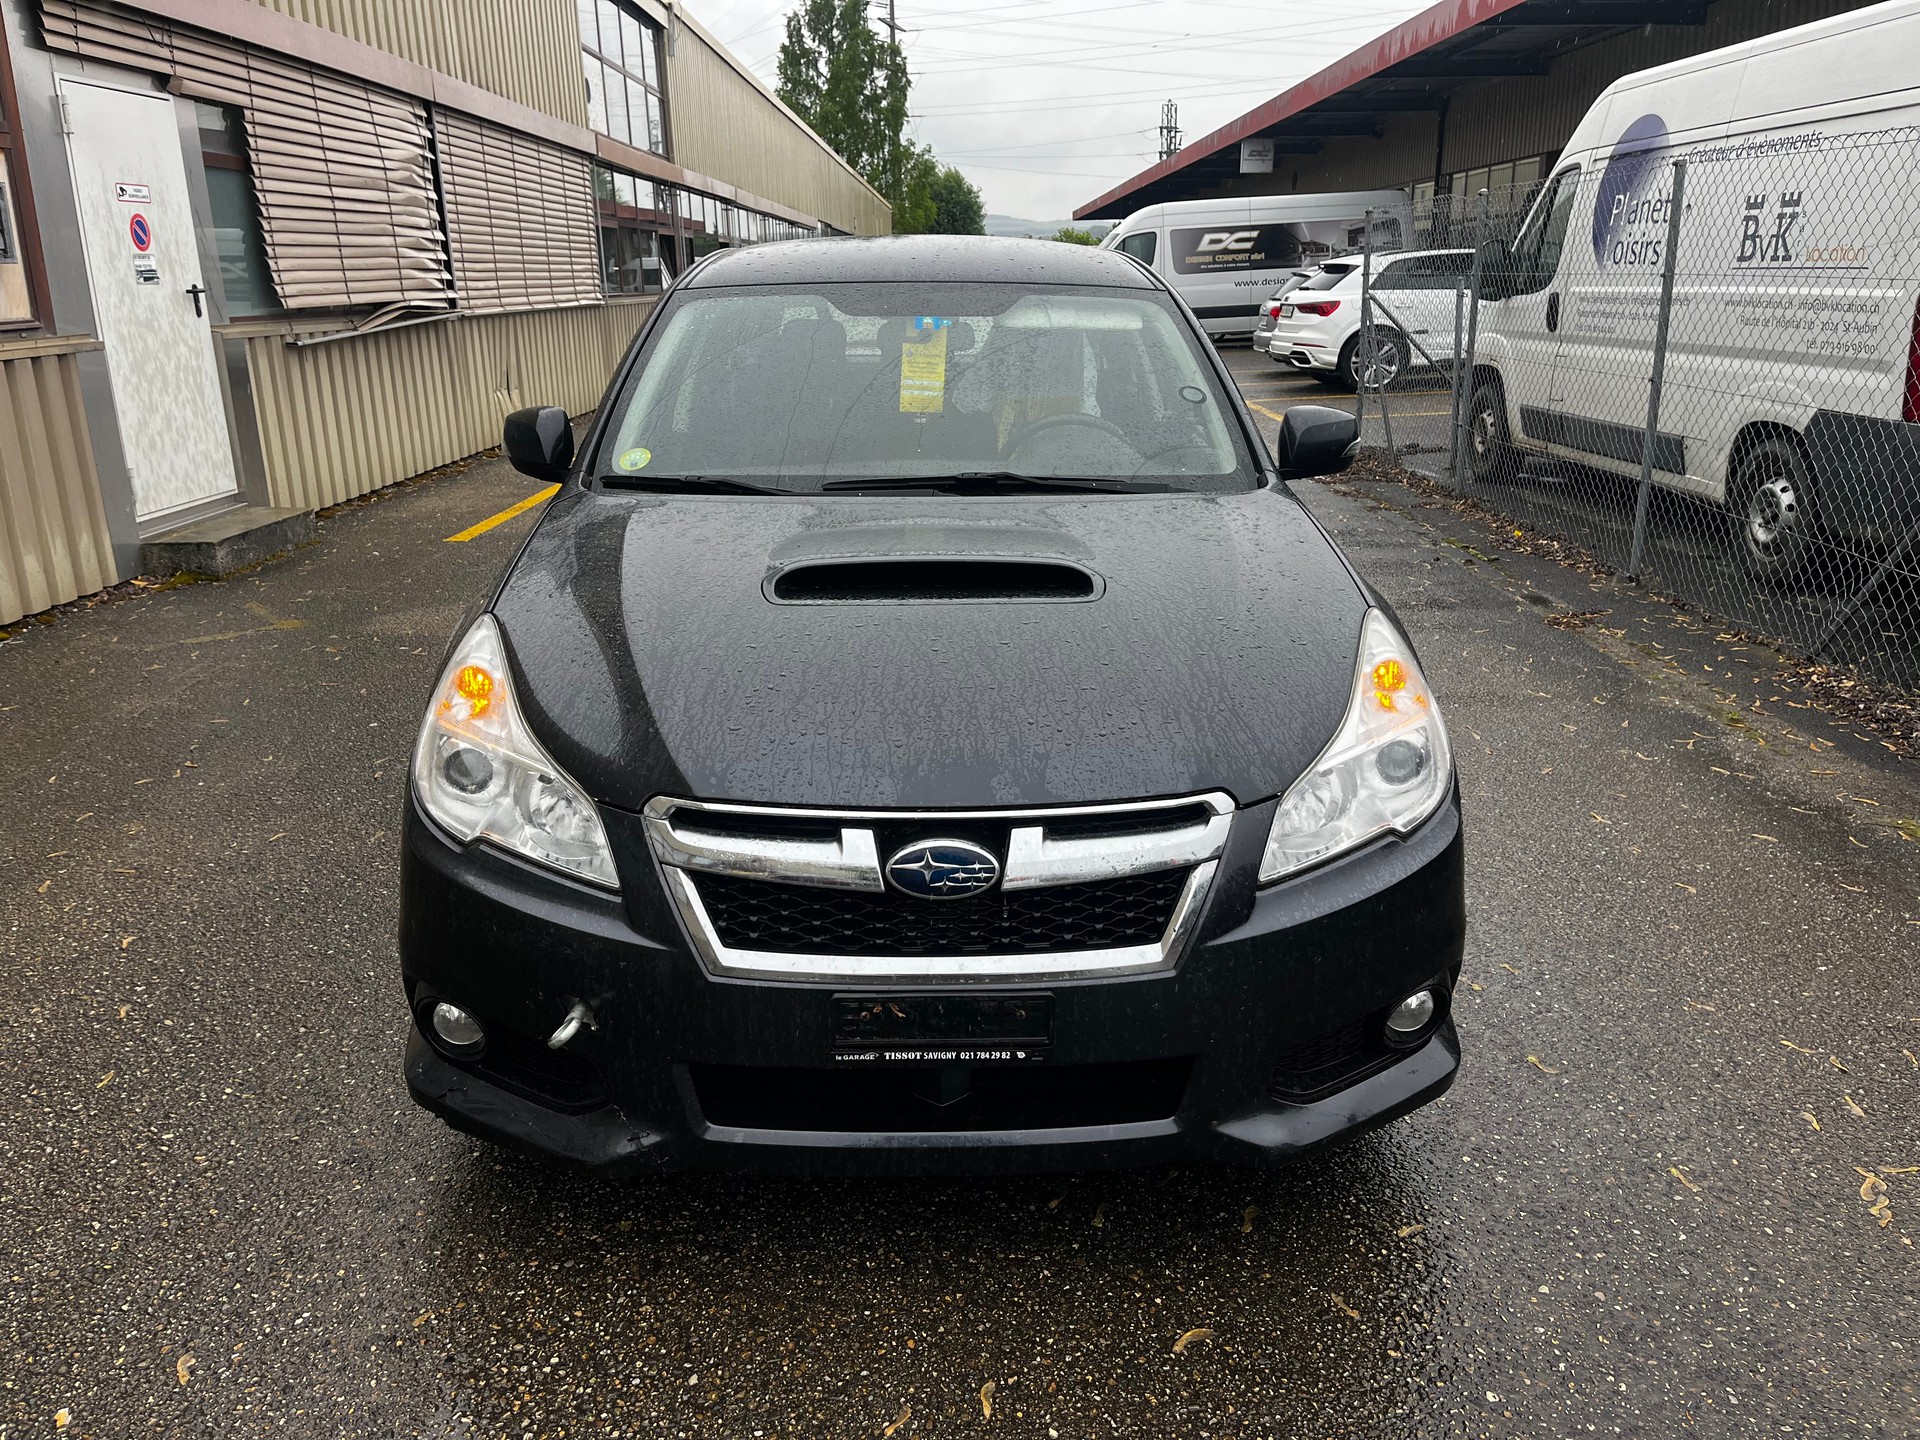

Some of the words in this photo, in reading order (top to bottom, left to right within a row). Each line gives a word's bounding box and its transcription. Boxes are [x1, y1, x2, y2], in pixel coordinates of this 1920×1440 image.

[1609, 187, 1672, 226] Planèt
[1195, 230, 1261, 252] DC
[884, 1051, 922, 1060] TISSOT
[923, 1051, 957, 1060] SAVIGNY
[960, 1051, 974, 1060] 021
[976, 1051, 990, 1060] 784
[990, 1051, 1001, 1060] 29
[1001, 1051, 1011, 1060] 82
